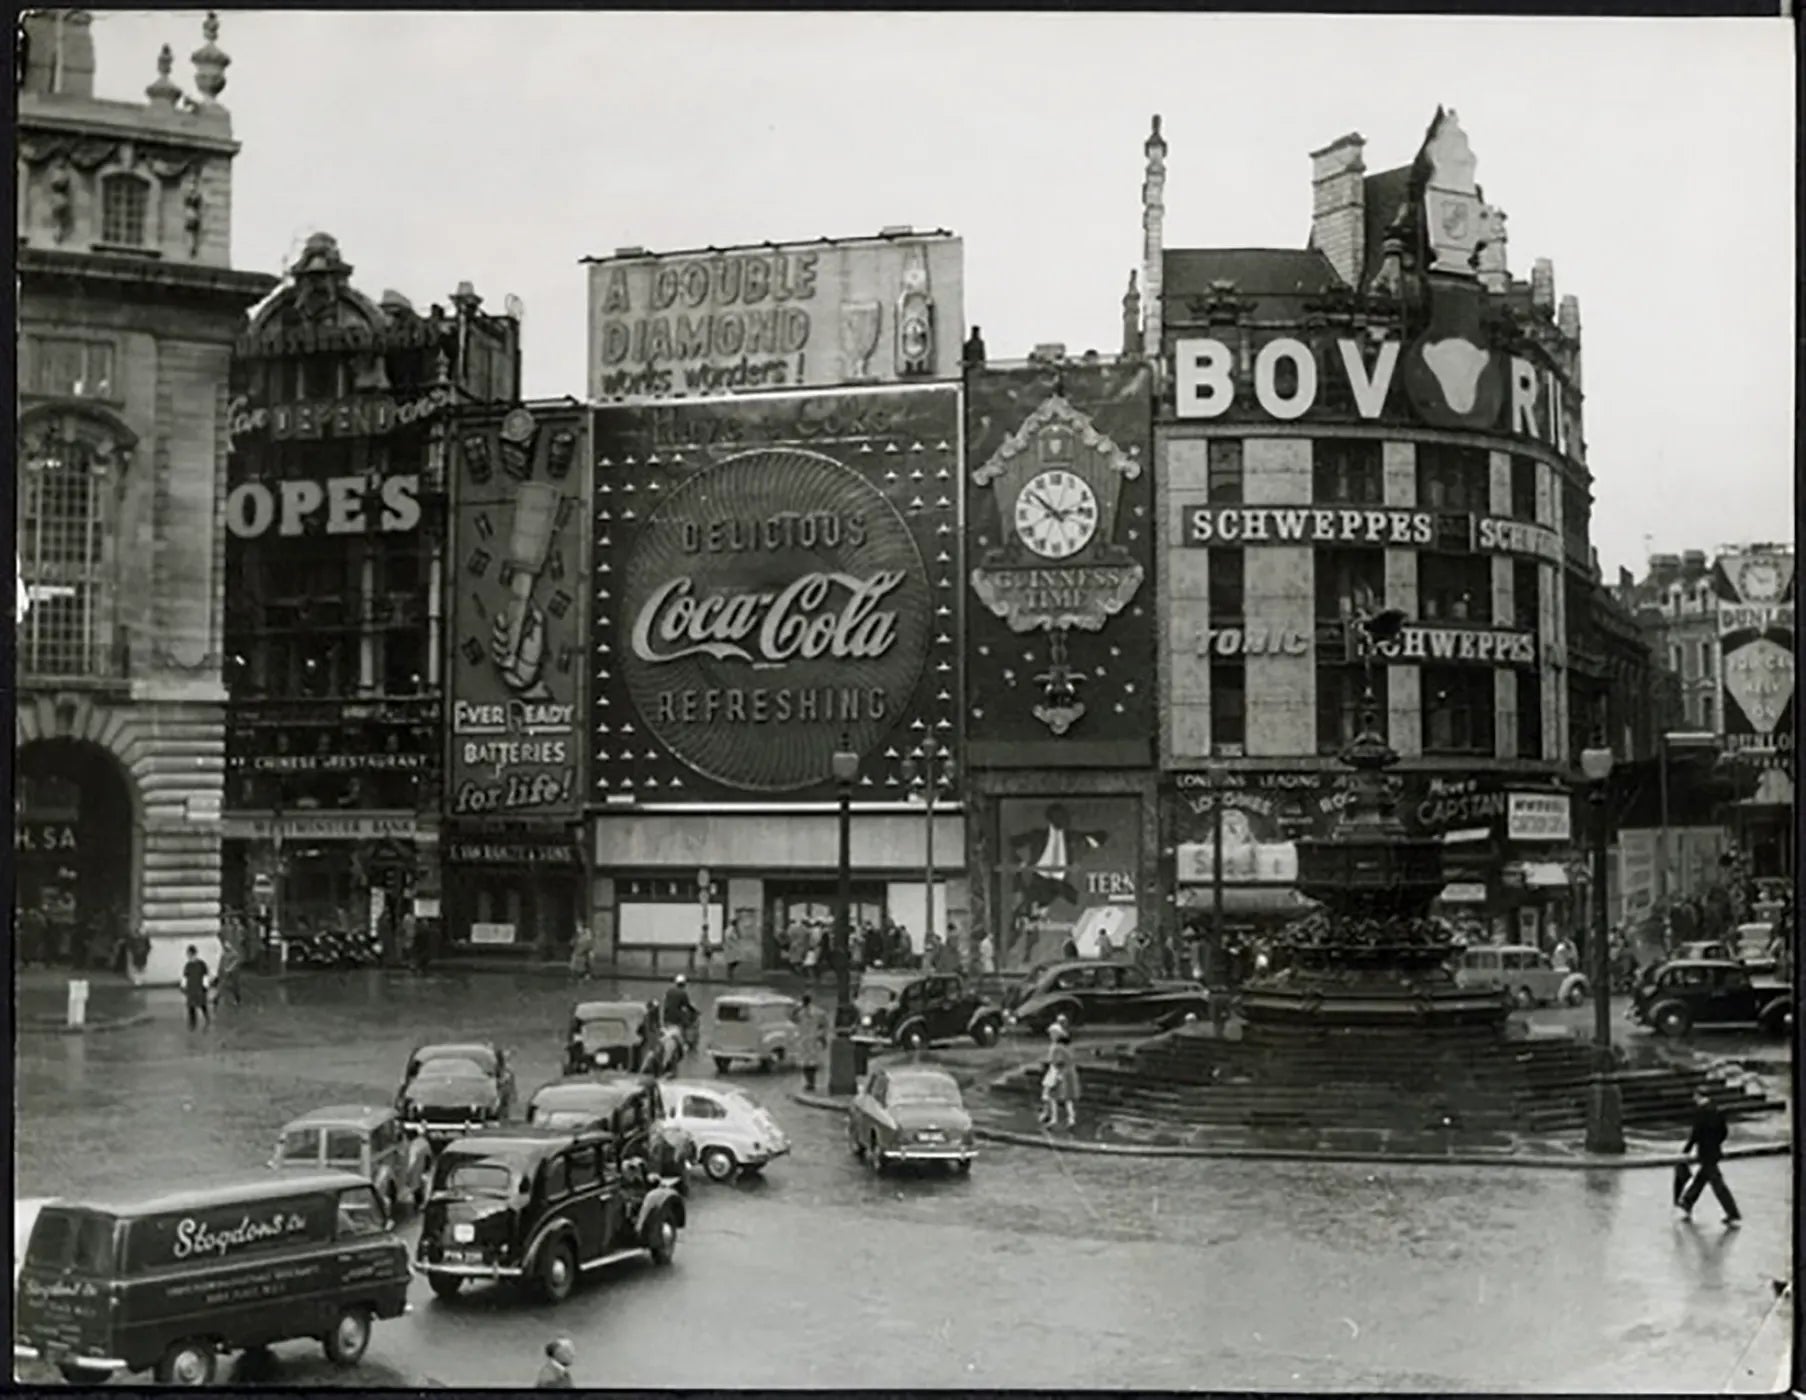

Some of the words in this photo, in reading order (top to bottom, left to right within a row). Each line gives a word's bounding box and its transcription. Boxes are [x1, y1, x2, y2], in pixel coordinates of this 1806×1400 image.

[603, 268, 630, 314] A
[655, 251, 818, 309] DOUBLE
[601, 306, 811, 367] DIAMOND
[601, 360, 673, 395] works
[682, 509, 869, 553] DELICIOUS
[1191, 507, 1433, 544] SCHWEPPES
[994, 568, 1121, 590] GUINNESS
[632, 568, 907, 663] Coca-Cola
[1028, 588, 1083, 610] TIME
[1195, 628, 1307, 656] TONIC
[454, 700, 505, 733] EVER
[506, 700, 575, 734] READY
[656, 686, 886, 722] REFRESHING
[463, 740, 566, 764] BATTERIES
[455, 781, 502, 812] for
